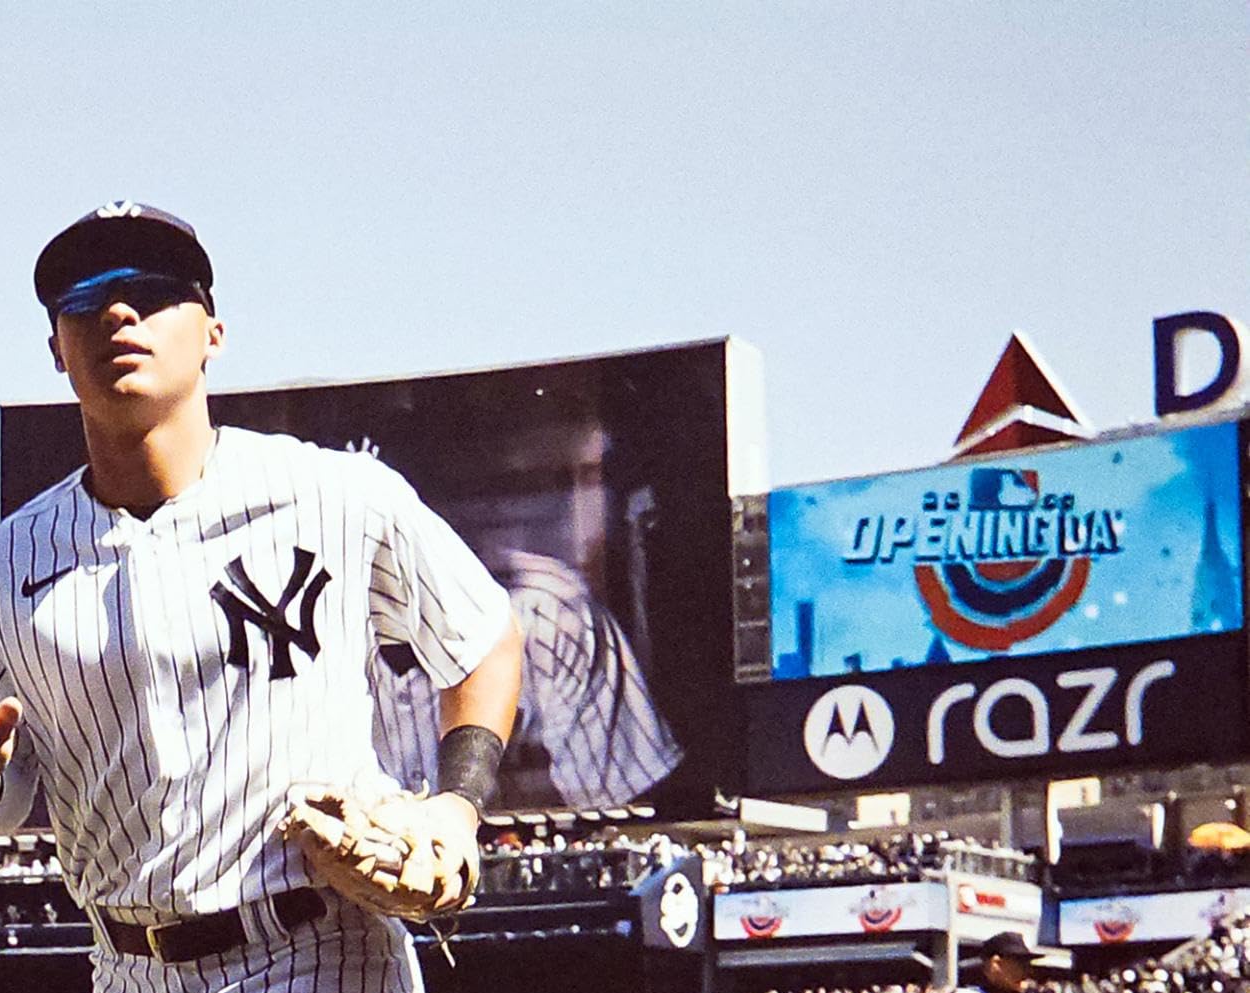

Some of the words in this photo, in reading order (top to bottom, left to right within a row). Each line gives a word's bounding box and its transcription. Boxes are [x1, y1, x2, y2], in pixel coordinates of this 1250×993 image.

[844, 510, 1052, 564] OPENING
[209, 546, 333, 680] NY
[927, 659, 1176, 765] razr
